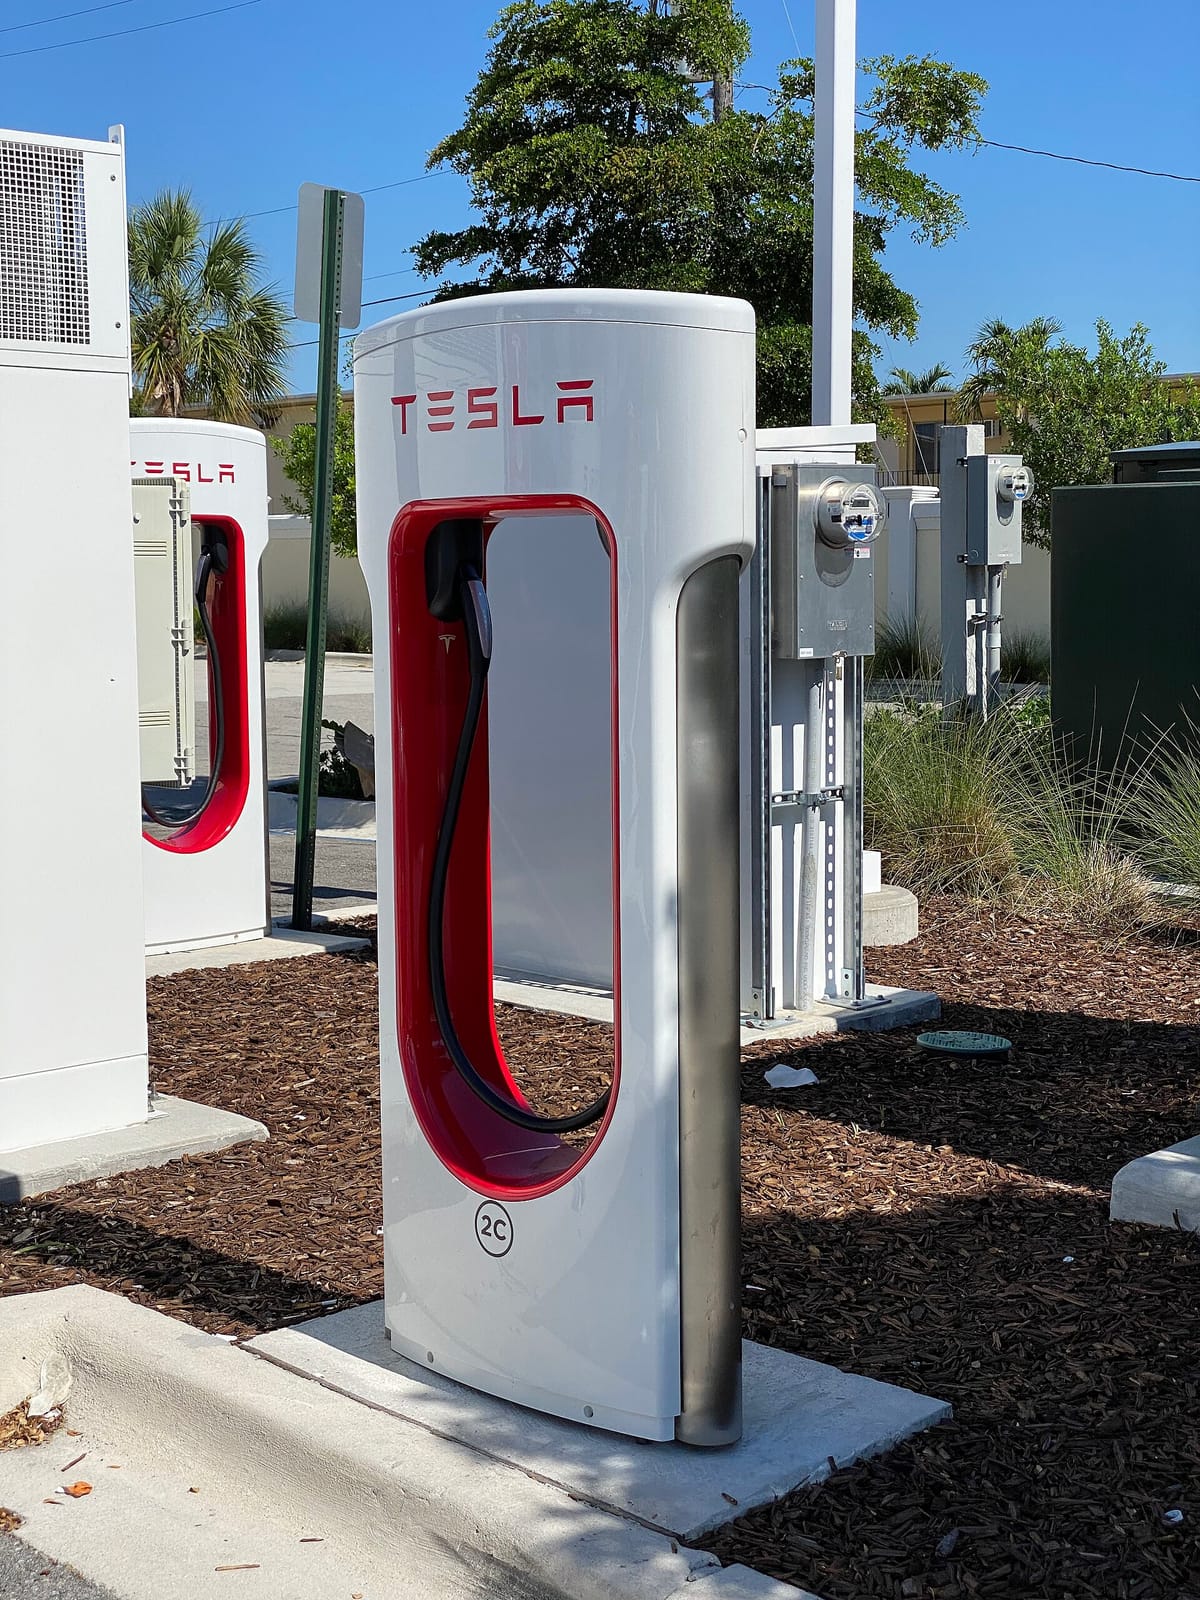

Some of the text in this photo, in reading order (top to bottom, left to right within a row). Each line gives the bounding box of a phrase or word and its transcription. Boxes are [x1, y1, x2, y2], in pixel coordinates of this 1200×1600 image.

[390, 379, 594, 435] TESLA
[130, 461, 235, 483] ESLA
[481, 1215, 507, 1241] 2C
